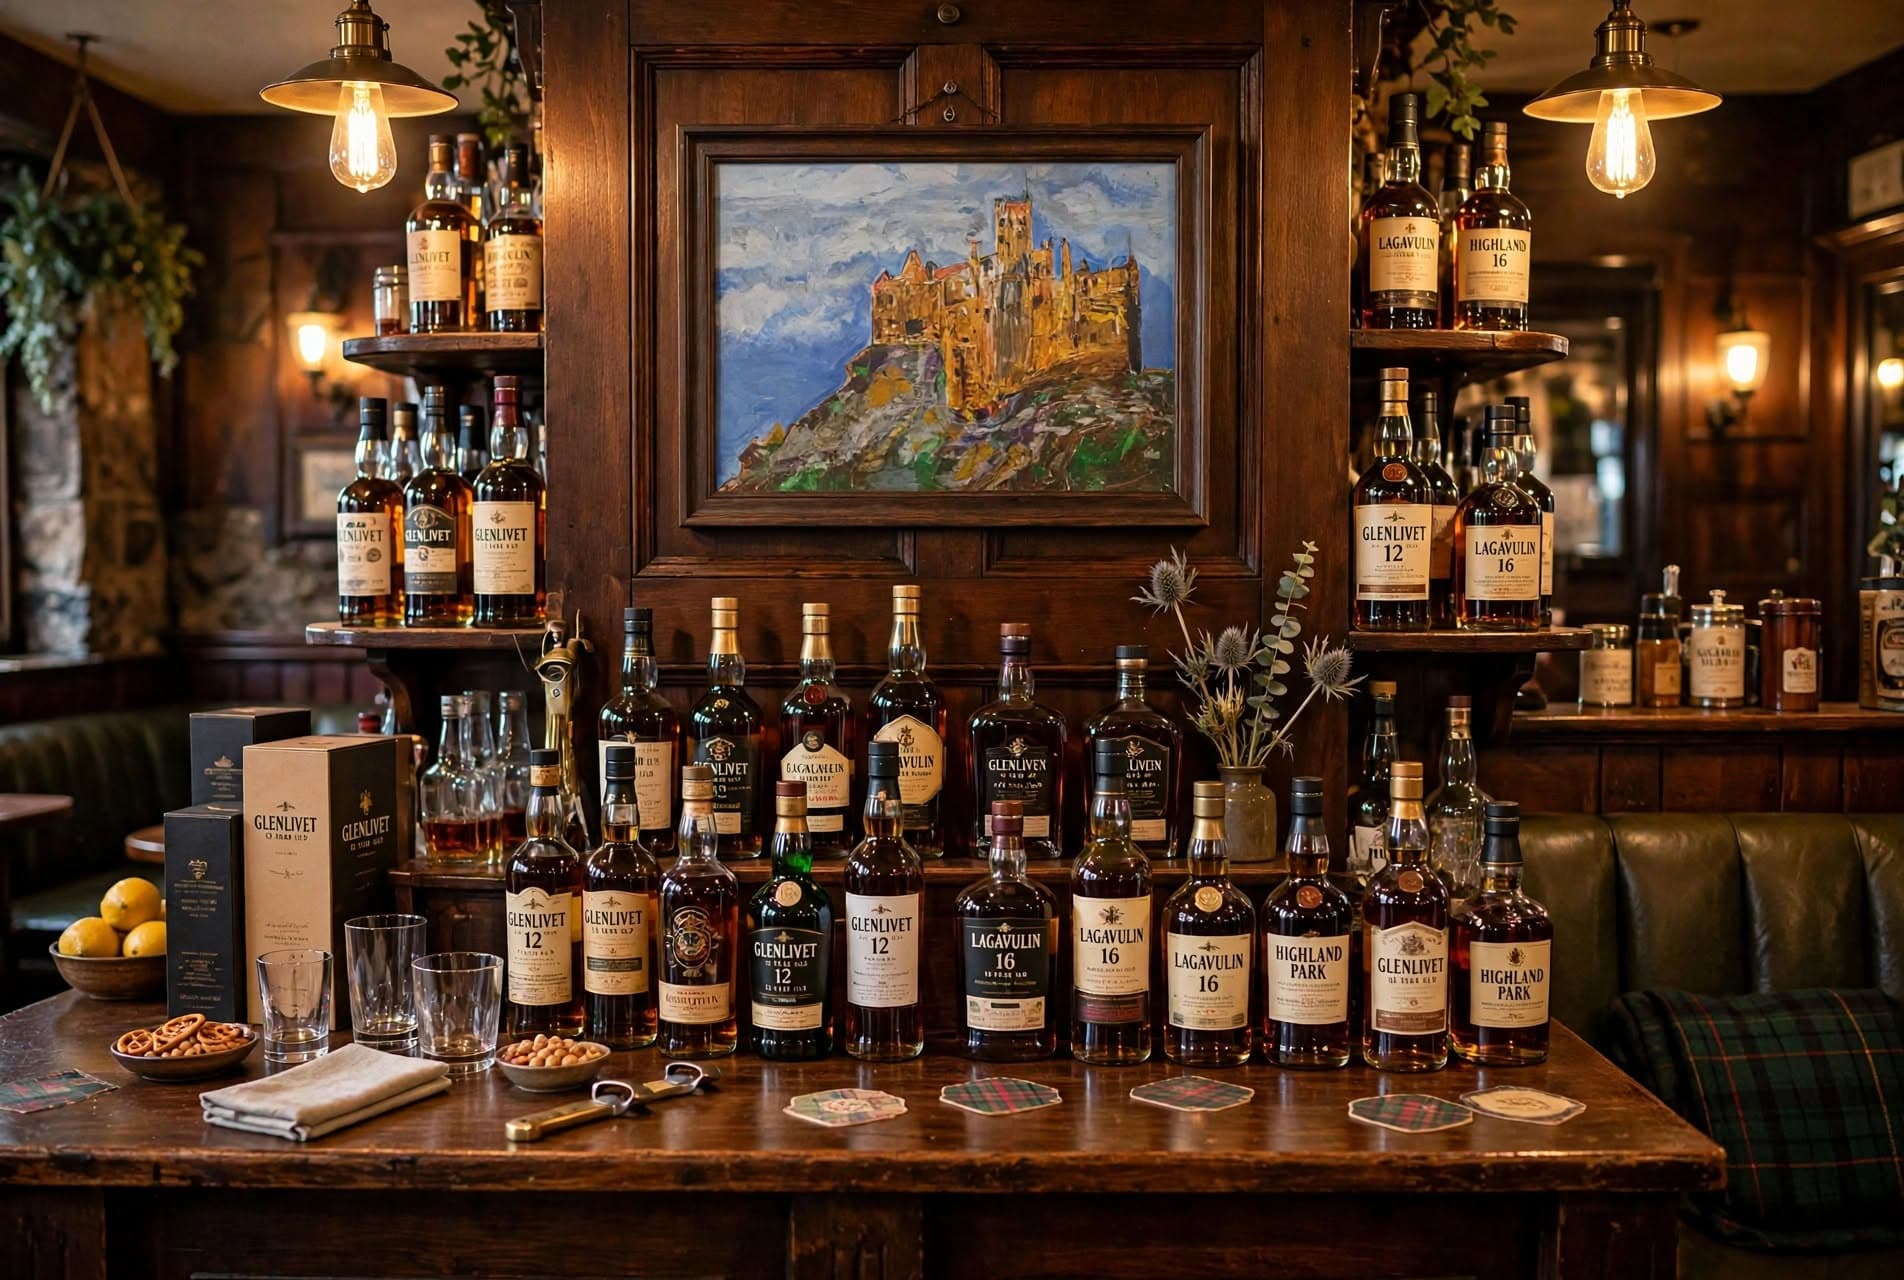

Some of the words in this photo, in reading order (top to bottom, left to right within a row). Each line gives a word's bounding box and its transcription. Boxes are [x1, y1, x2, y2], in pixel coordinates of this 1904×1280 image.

[1378, 236, 1436, 250] LAGAVULIN
[1469, 239, 1527, 252] HIGHLAND
[1492, 253, 1508, 268] 16
[475, 527, 528, 542] GLENLIVET
[1362, 526, 1426, 541] GLENLIVET
[1384, 544, 1404, 562] 12
[1475, 540, 1536, 556] LAGAVULIN
[1498, 559, 1514, 573] 16
[254, 815, 317, 833] GLENLIVET
[342, 815, 391, 842] GLENLIVET
[508, 911, 566, 929] GLENLIVET
[584, 909, 642, 926] GLENLIVET
[851, 916, 913, 933] GLENLIVET
[524, 931, 542, 949] 12
[971, 933, 1041, 949] LAGAVULIN
[1080, 927, 1144, 945] LAGAVULIN
[754, 942, 817, 958] GLENLIVET
[871, 937, 889, 955] 12
[1276, 944, 1343, 963] HIGHLAND
[996, 952, 1016, 971] 16
[1102, 947, 1120, 965] 16
[1175, 952, 1243, 970] LAGAVULIN
[1290, 963, 1327, 981] PARK
[1377, 956, 1444, 975] GLENLIVET
[775, 968, 792, 985] 12
[1199, 974, 1219, 993] 16
[1480, 968, 1544, 985] HIGHLAND
[1498, 985, 1531, 1001] PARK
